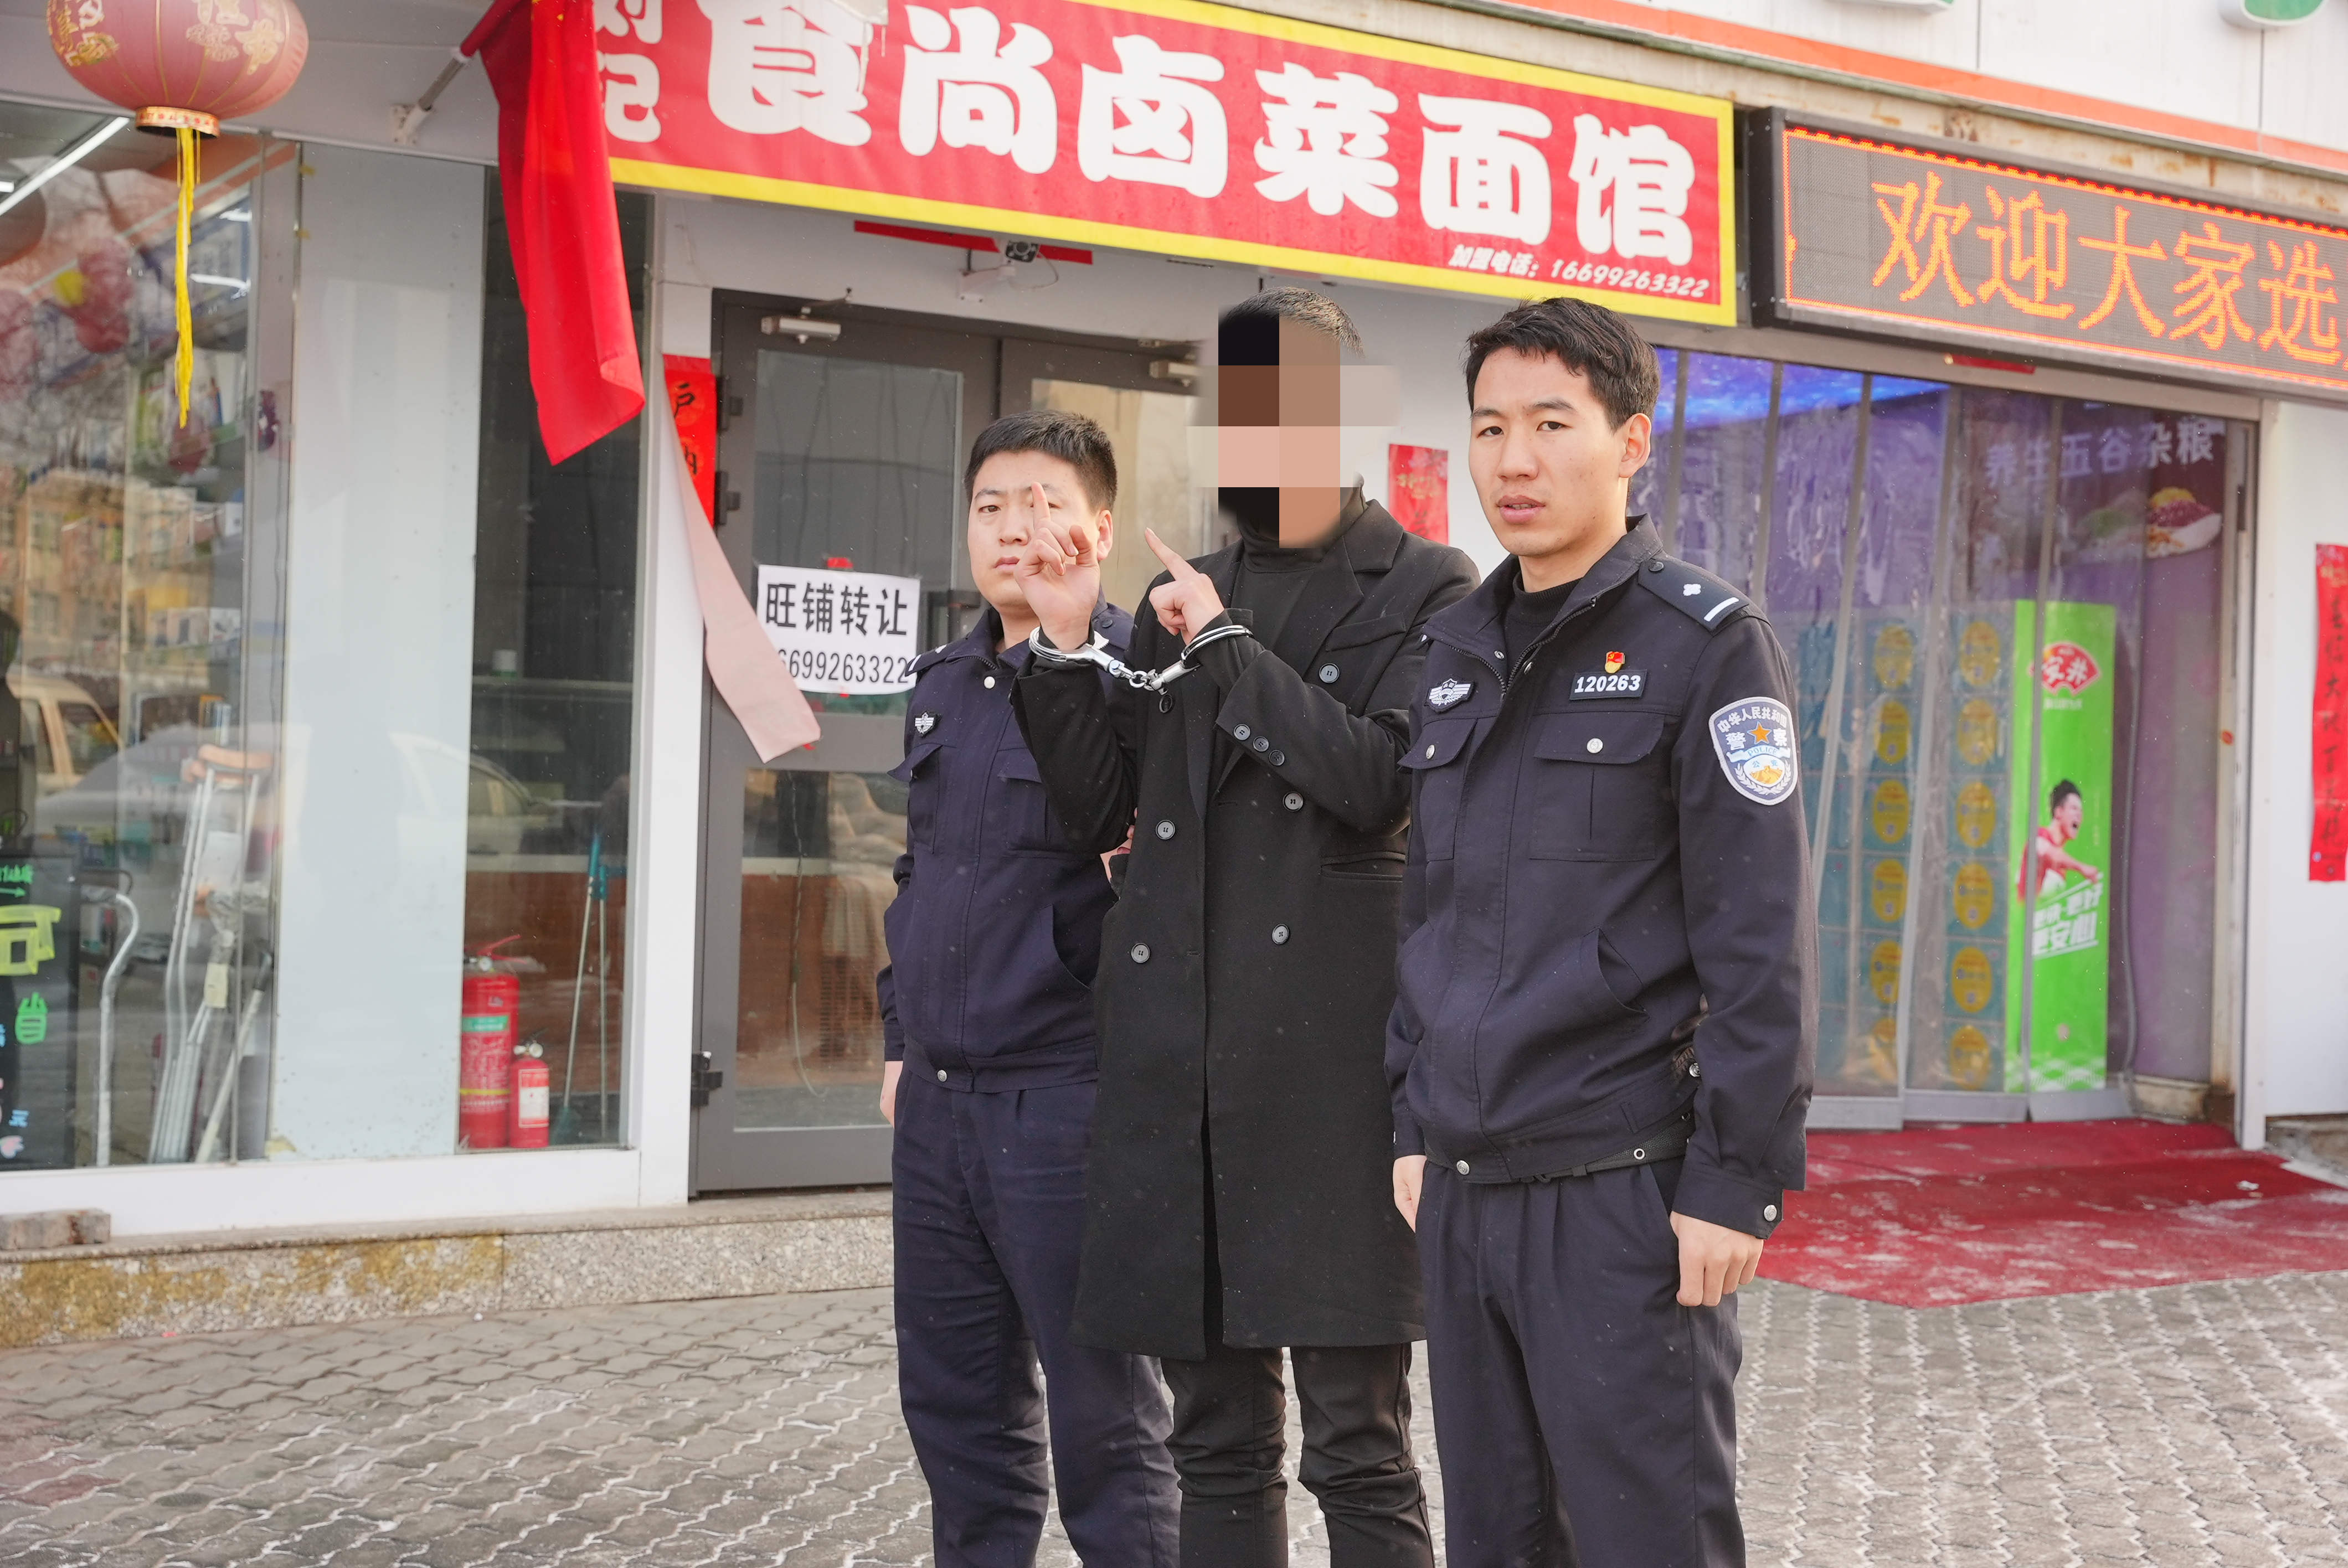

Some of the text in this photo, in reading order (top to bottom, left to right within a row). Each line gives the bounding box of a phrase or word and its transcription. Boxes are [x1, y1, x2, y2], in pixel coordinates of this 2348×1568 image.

[697, 0, 1695, 266] 食尚卤菜面馆
[1551, 259, 1710, 298] 16699263322
[1871, 171, 2348, 370] 欢迎大家选
[766, 581, 907, 636] 旺铺转让
[1574, 674, 1641, 693] 120263
[2041, 656, 2088, 684] 安井
[1717, 706, 1787, 733] 中华人民共和国
[1747, 746, 1777, 756] POLICE
